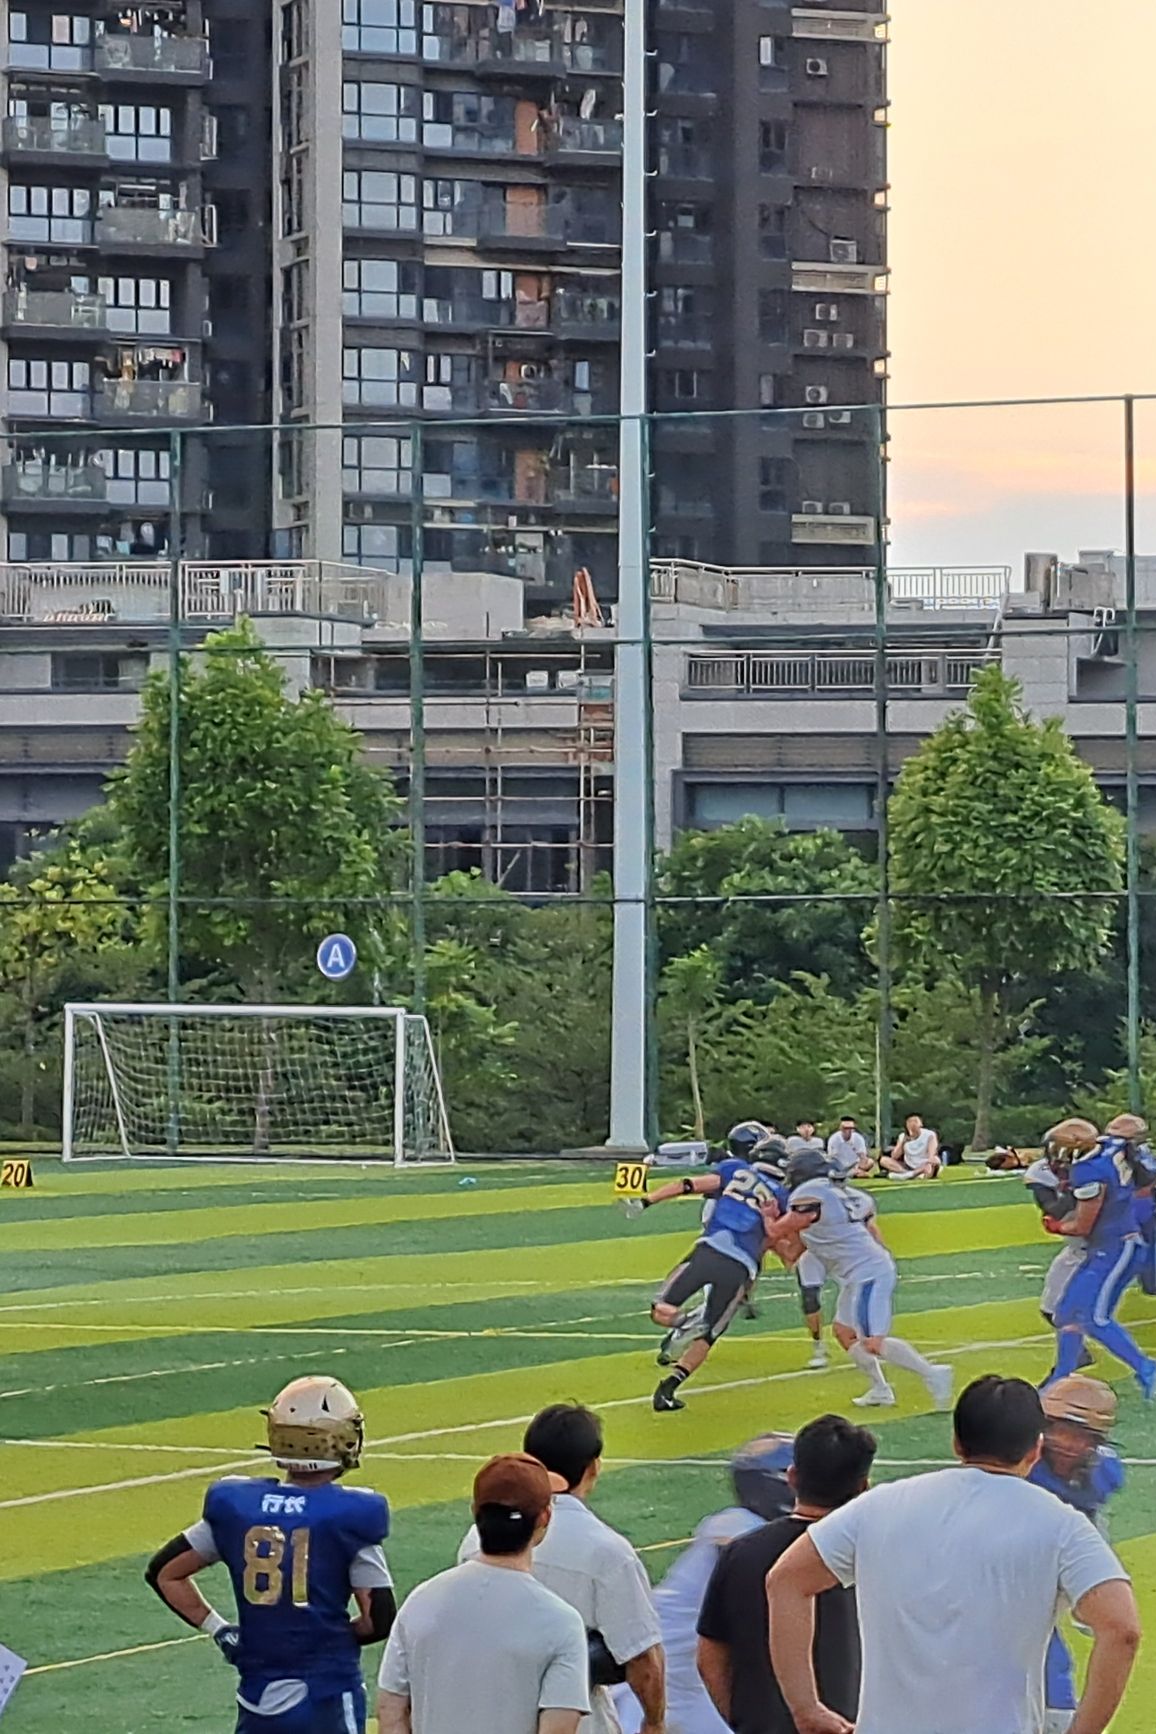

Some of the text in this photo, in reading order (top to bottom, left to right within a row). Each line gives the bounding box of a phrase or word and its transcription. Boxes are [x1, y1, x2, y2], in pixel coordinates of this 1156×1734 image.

[327, 943, 345, 968] A
[2, 1163, 25, 1187] 20
[616, 1166, 642, 1189] 30
[243, 1525, 311, 1607] 81
